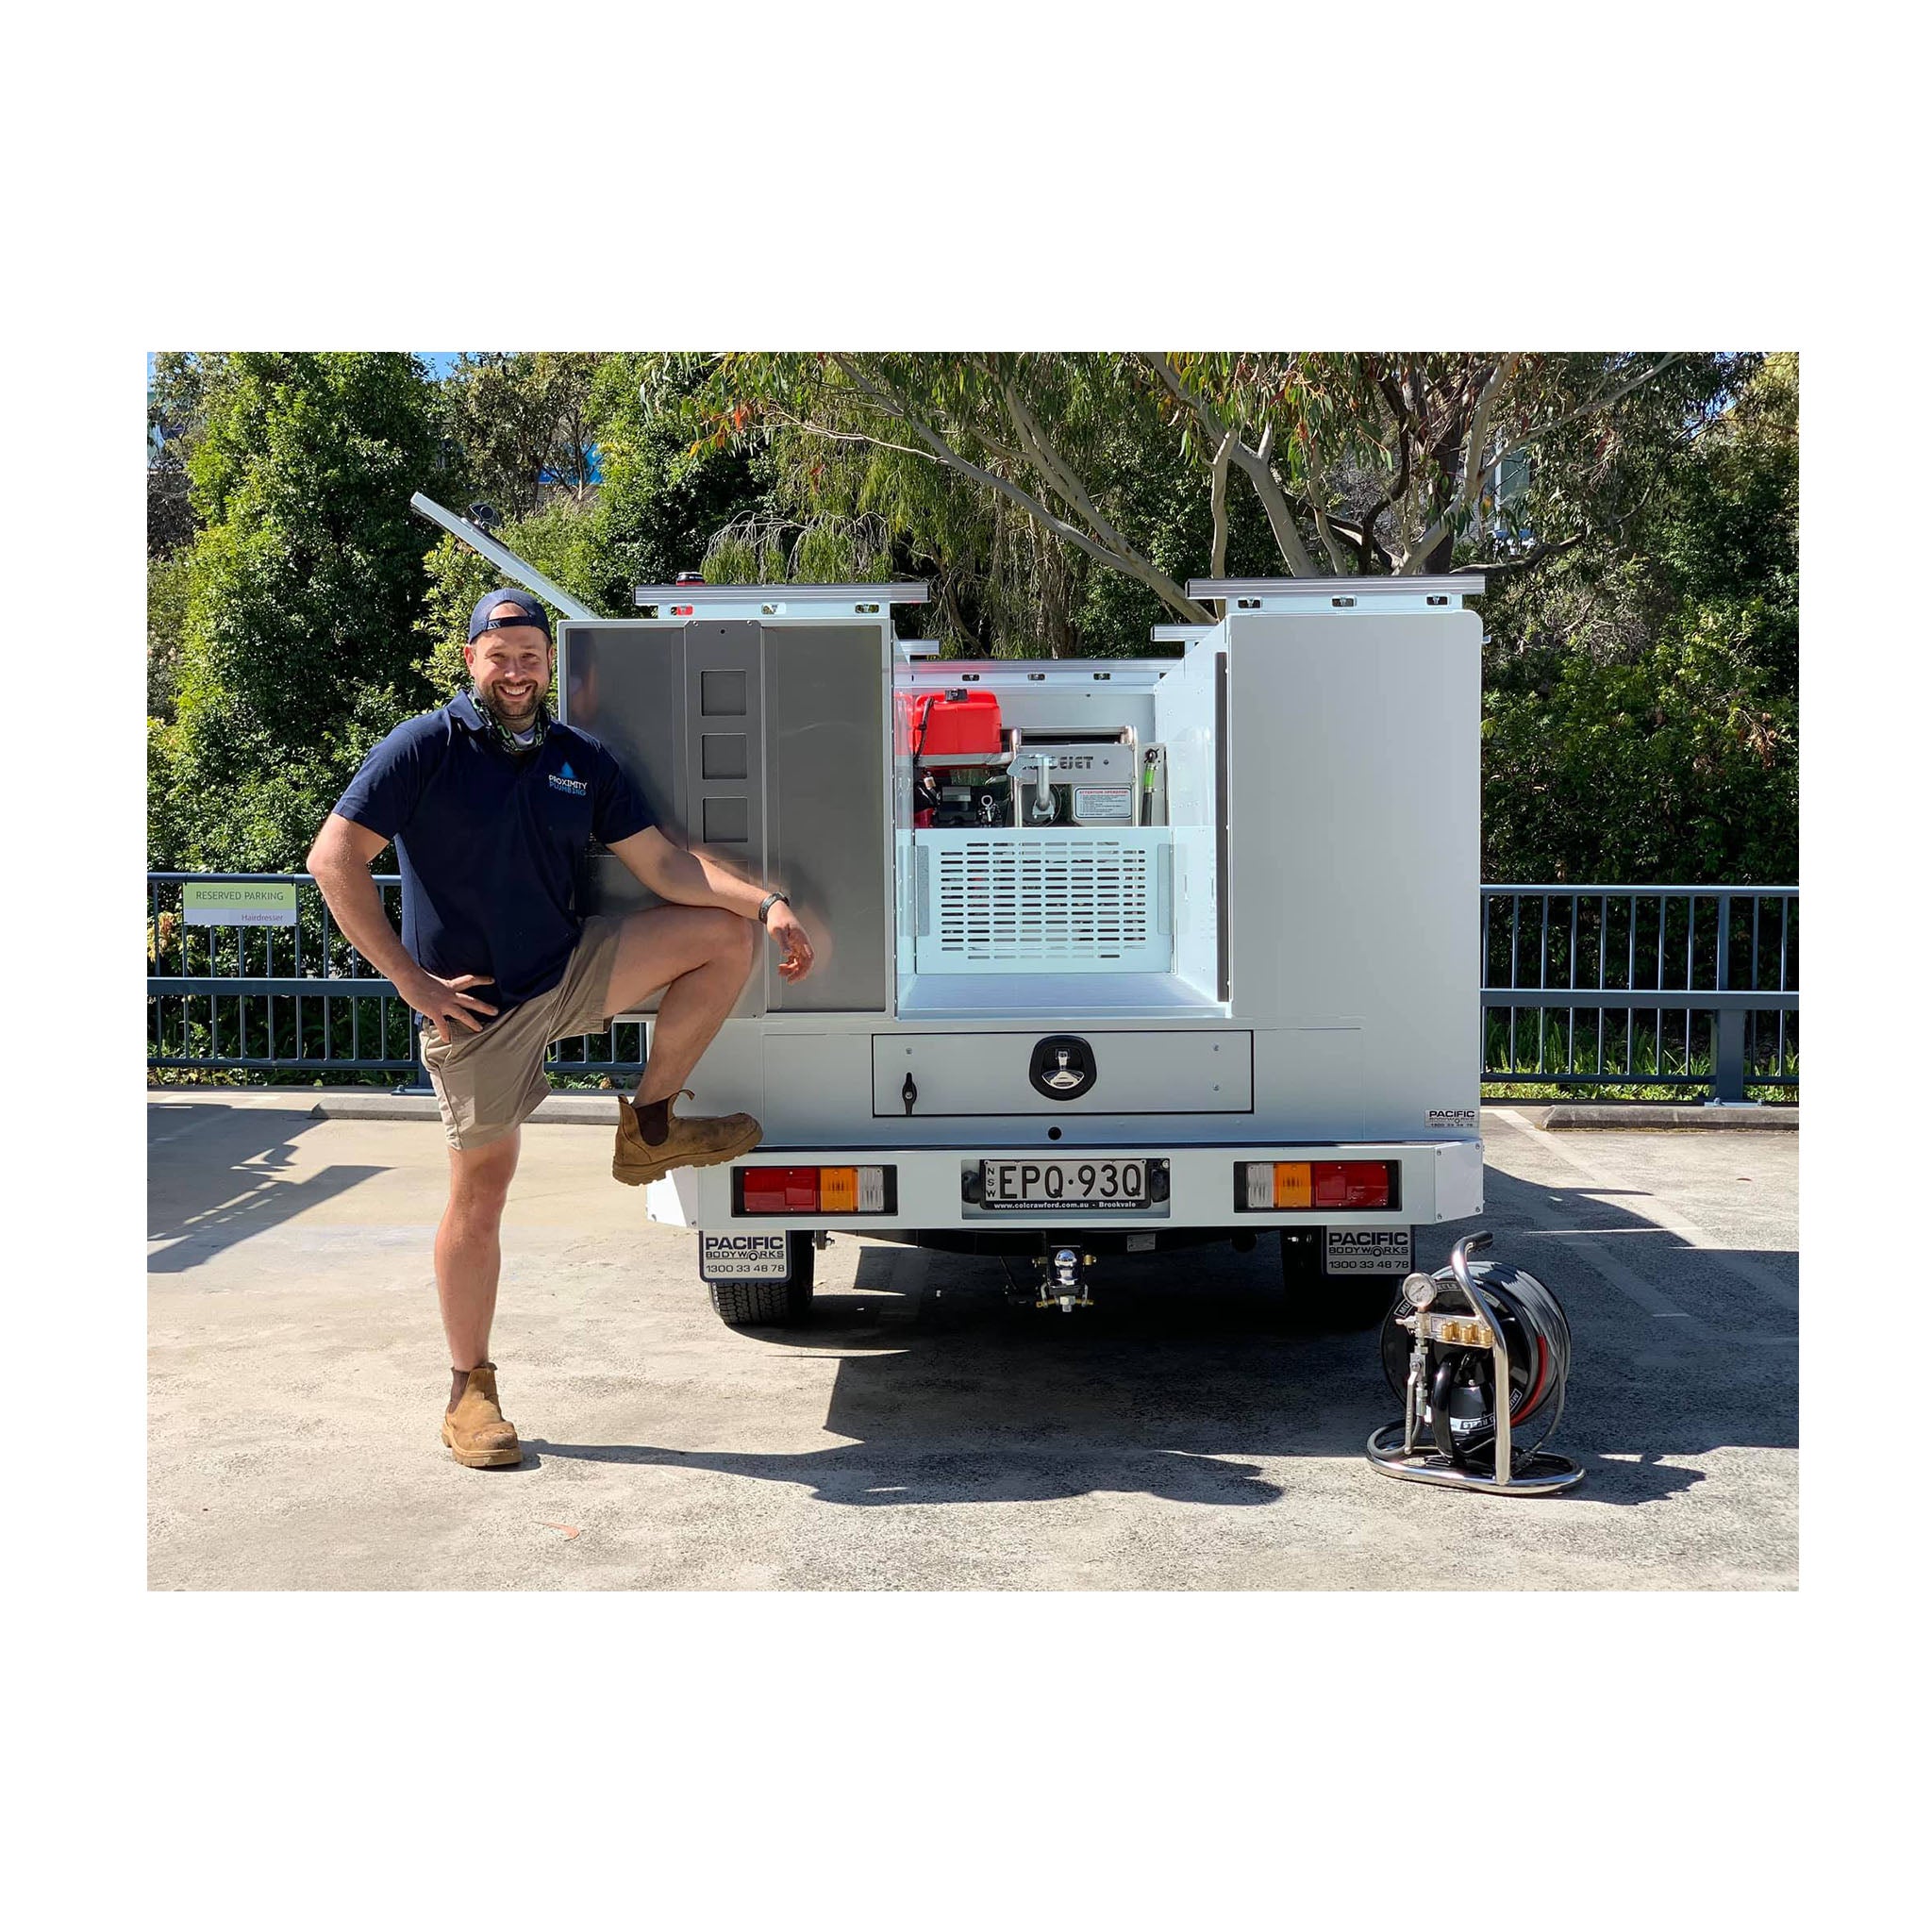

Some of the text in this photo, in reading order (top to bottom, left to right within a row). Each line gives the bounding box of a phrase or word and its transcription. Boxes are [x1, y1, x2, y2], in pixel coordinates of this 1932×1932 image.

[548, 774, 588, 790] PROXIMITY
[195, 891, 284, 901] RESERVED PARKING
[242, 913, 284, 922] Hairdresser
[705, 1236, 784, 1250] PACIFIC
[1328, 1232, 1408, 1246] PACIFIC
[706, 1250, 785, 1260] BODYWORKS
[1328, 1245, 1409, 1257] BODYWORKS
[706, 1264, 785, 1273] 1300 33 48 78
[1328, 1260, 1409, 1269] 1300 33 48 78
